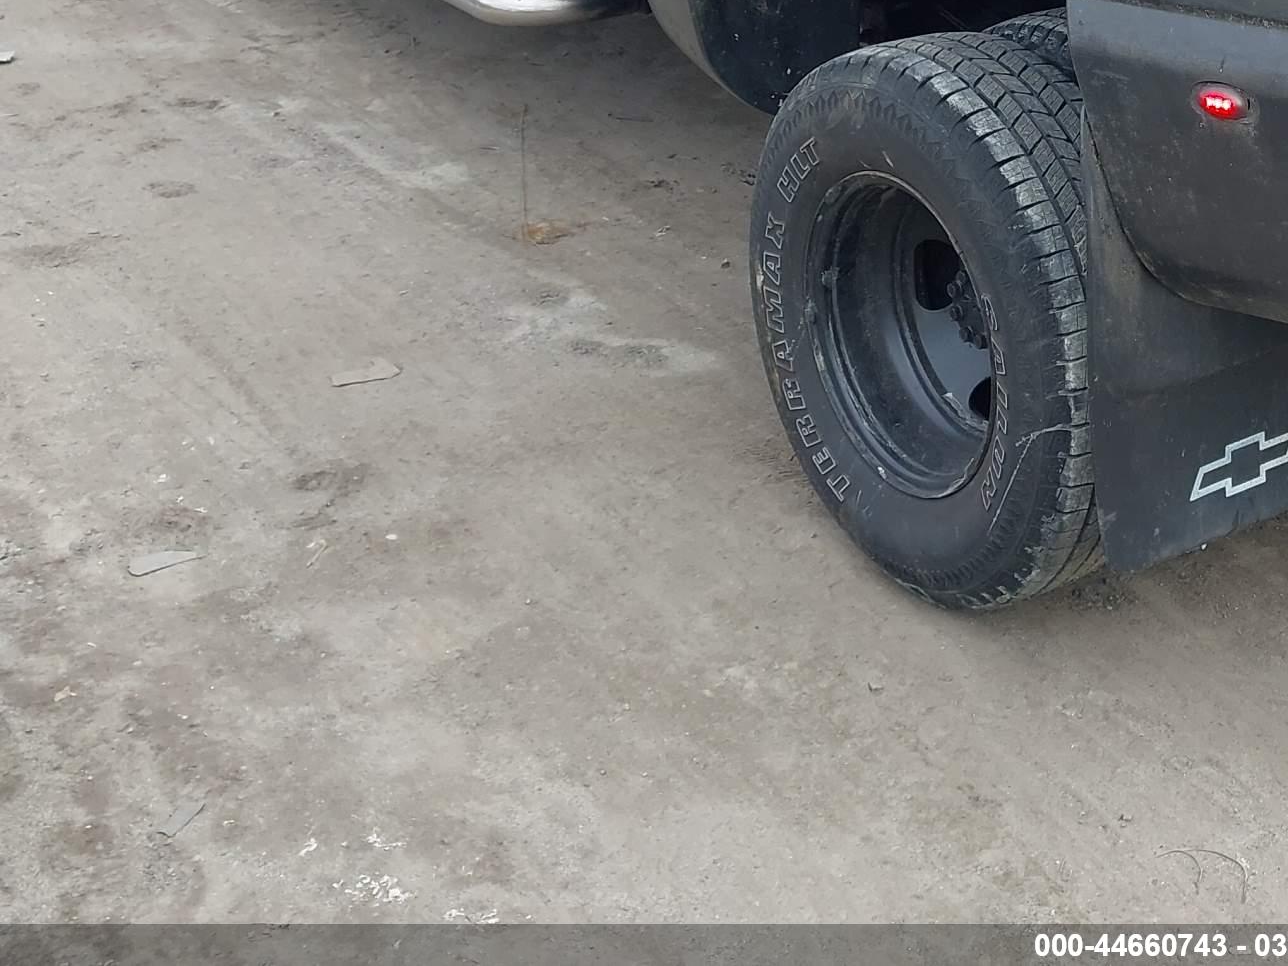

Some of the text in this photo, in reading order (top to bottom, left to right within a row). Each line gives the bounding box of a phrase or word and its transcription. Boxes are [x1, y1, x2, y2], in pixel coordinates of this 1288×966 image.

[763, 136, 850, 501] TERRAMAX HLT
[980, 294, 1008, 511] SAILUN
